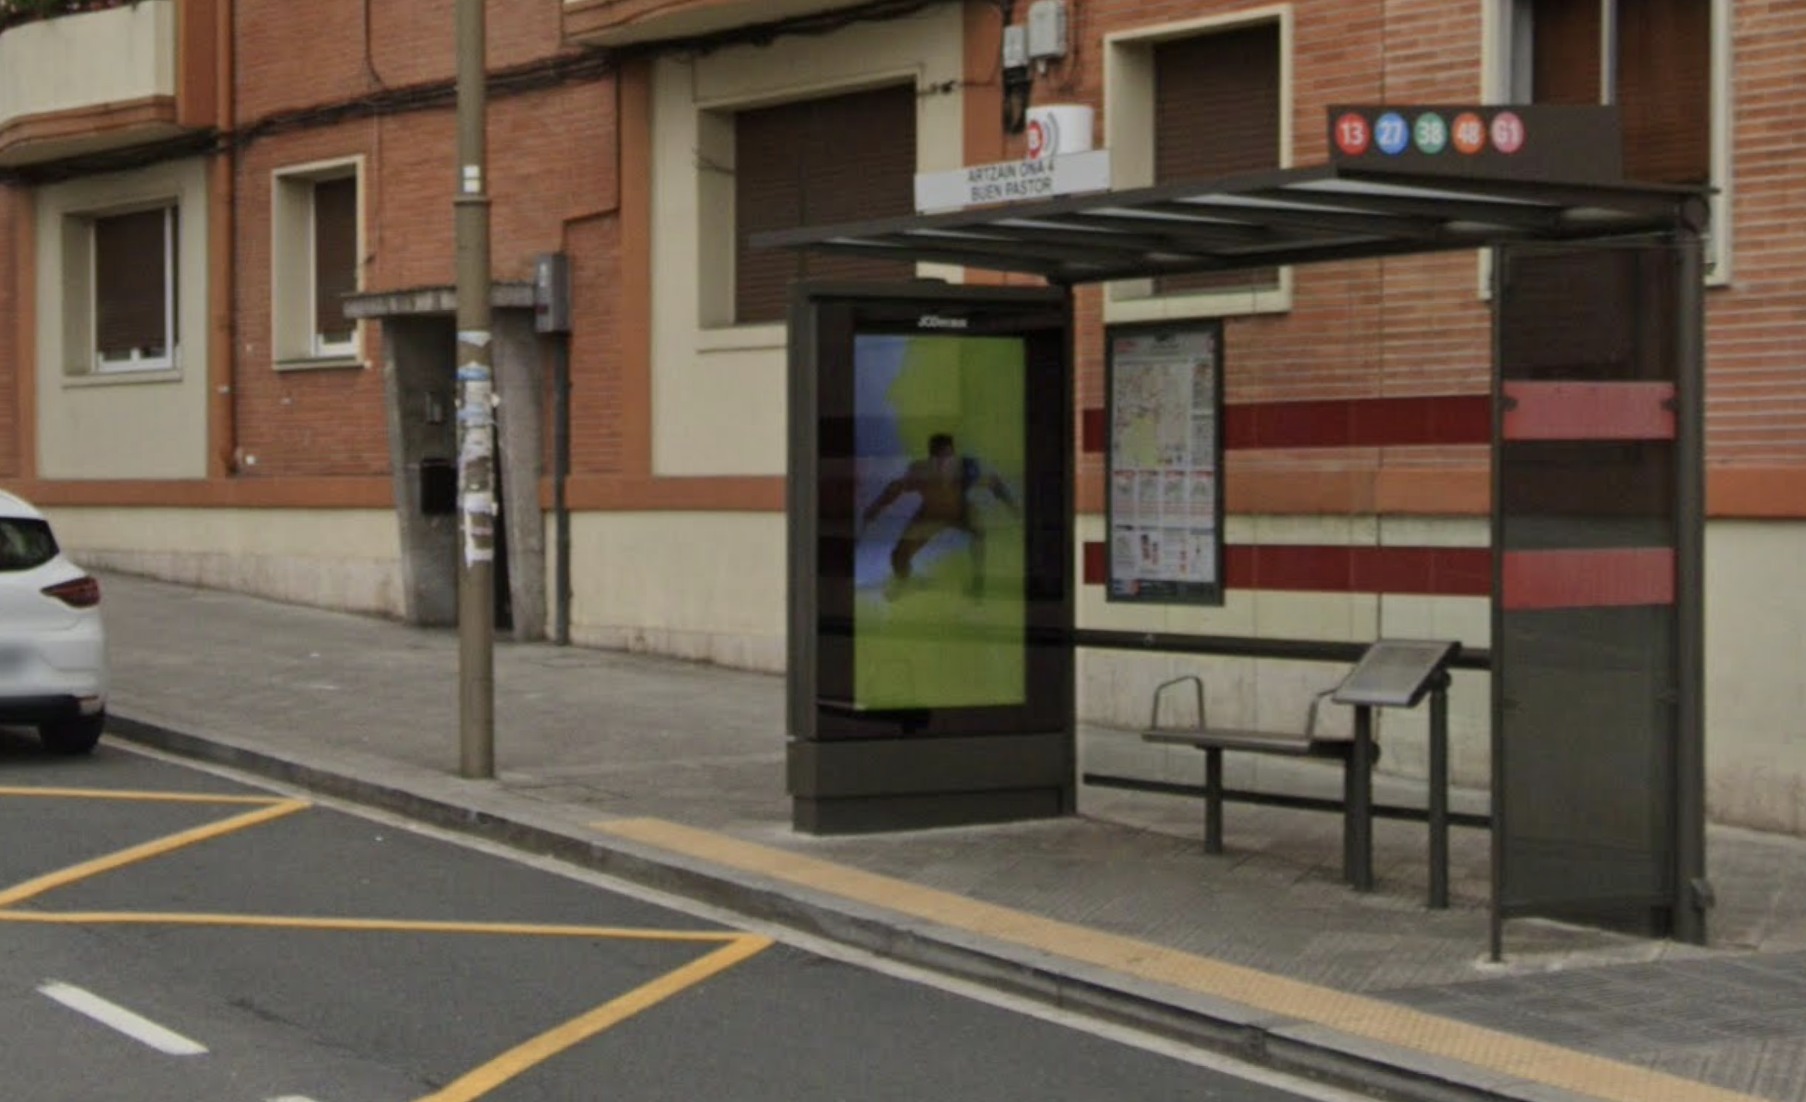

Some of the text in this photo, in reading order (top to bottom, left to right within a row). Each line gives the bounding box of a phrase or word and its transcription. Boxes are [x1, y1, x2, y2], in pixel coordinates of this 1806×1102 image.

[1342, 121, 1364, 145] 13
[1380, 121, 1402, 145] 27
[1420, 121, 1445, 145] 38
[1457, 121, 1481, 145] 48
[1494, 121, 1519, 145] 61
[968, 165, 1016, 182] ARTZAIN
[1021, 161, 1043, 177] ONA
[971, 177, 1052, 202] BUEN PASTOR
